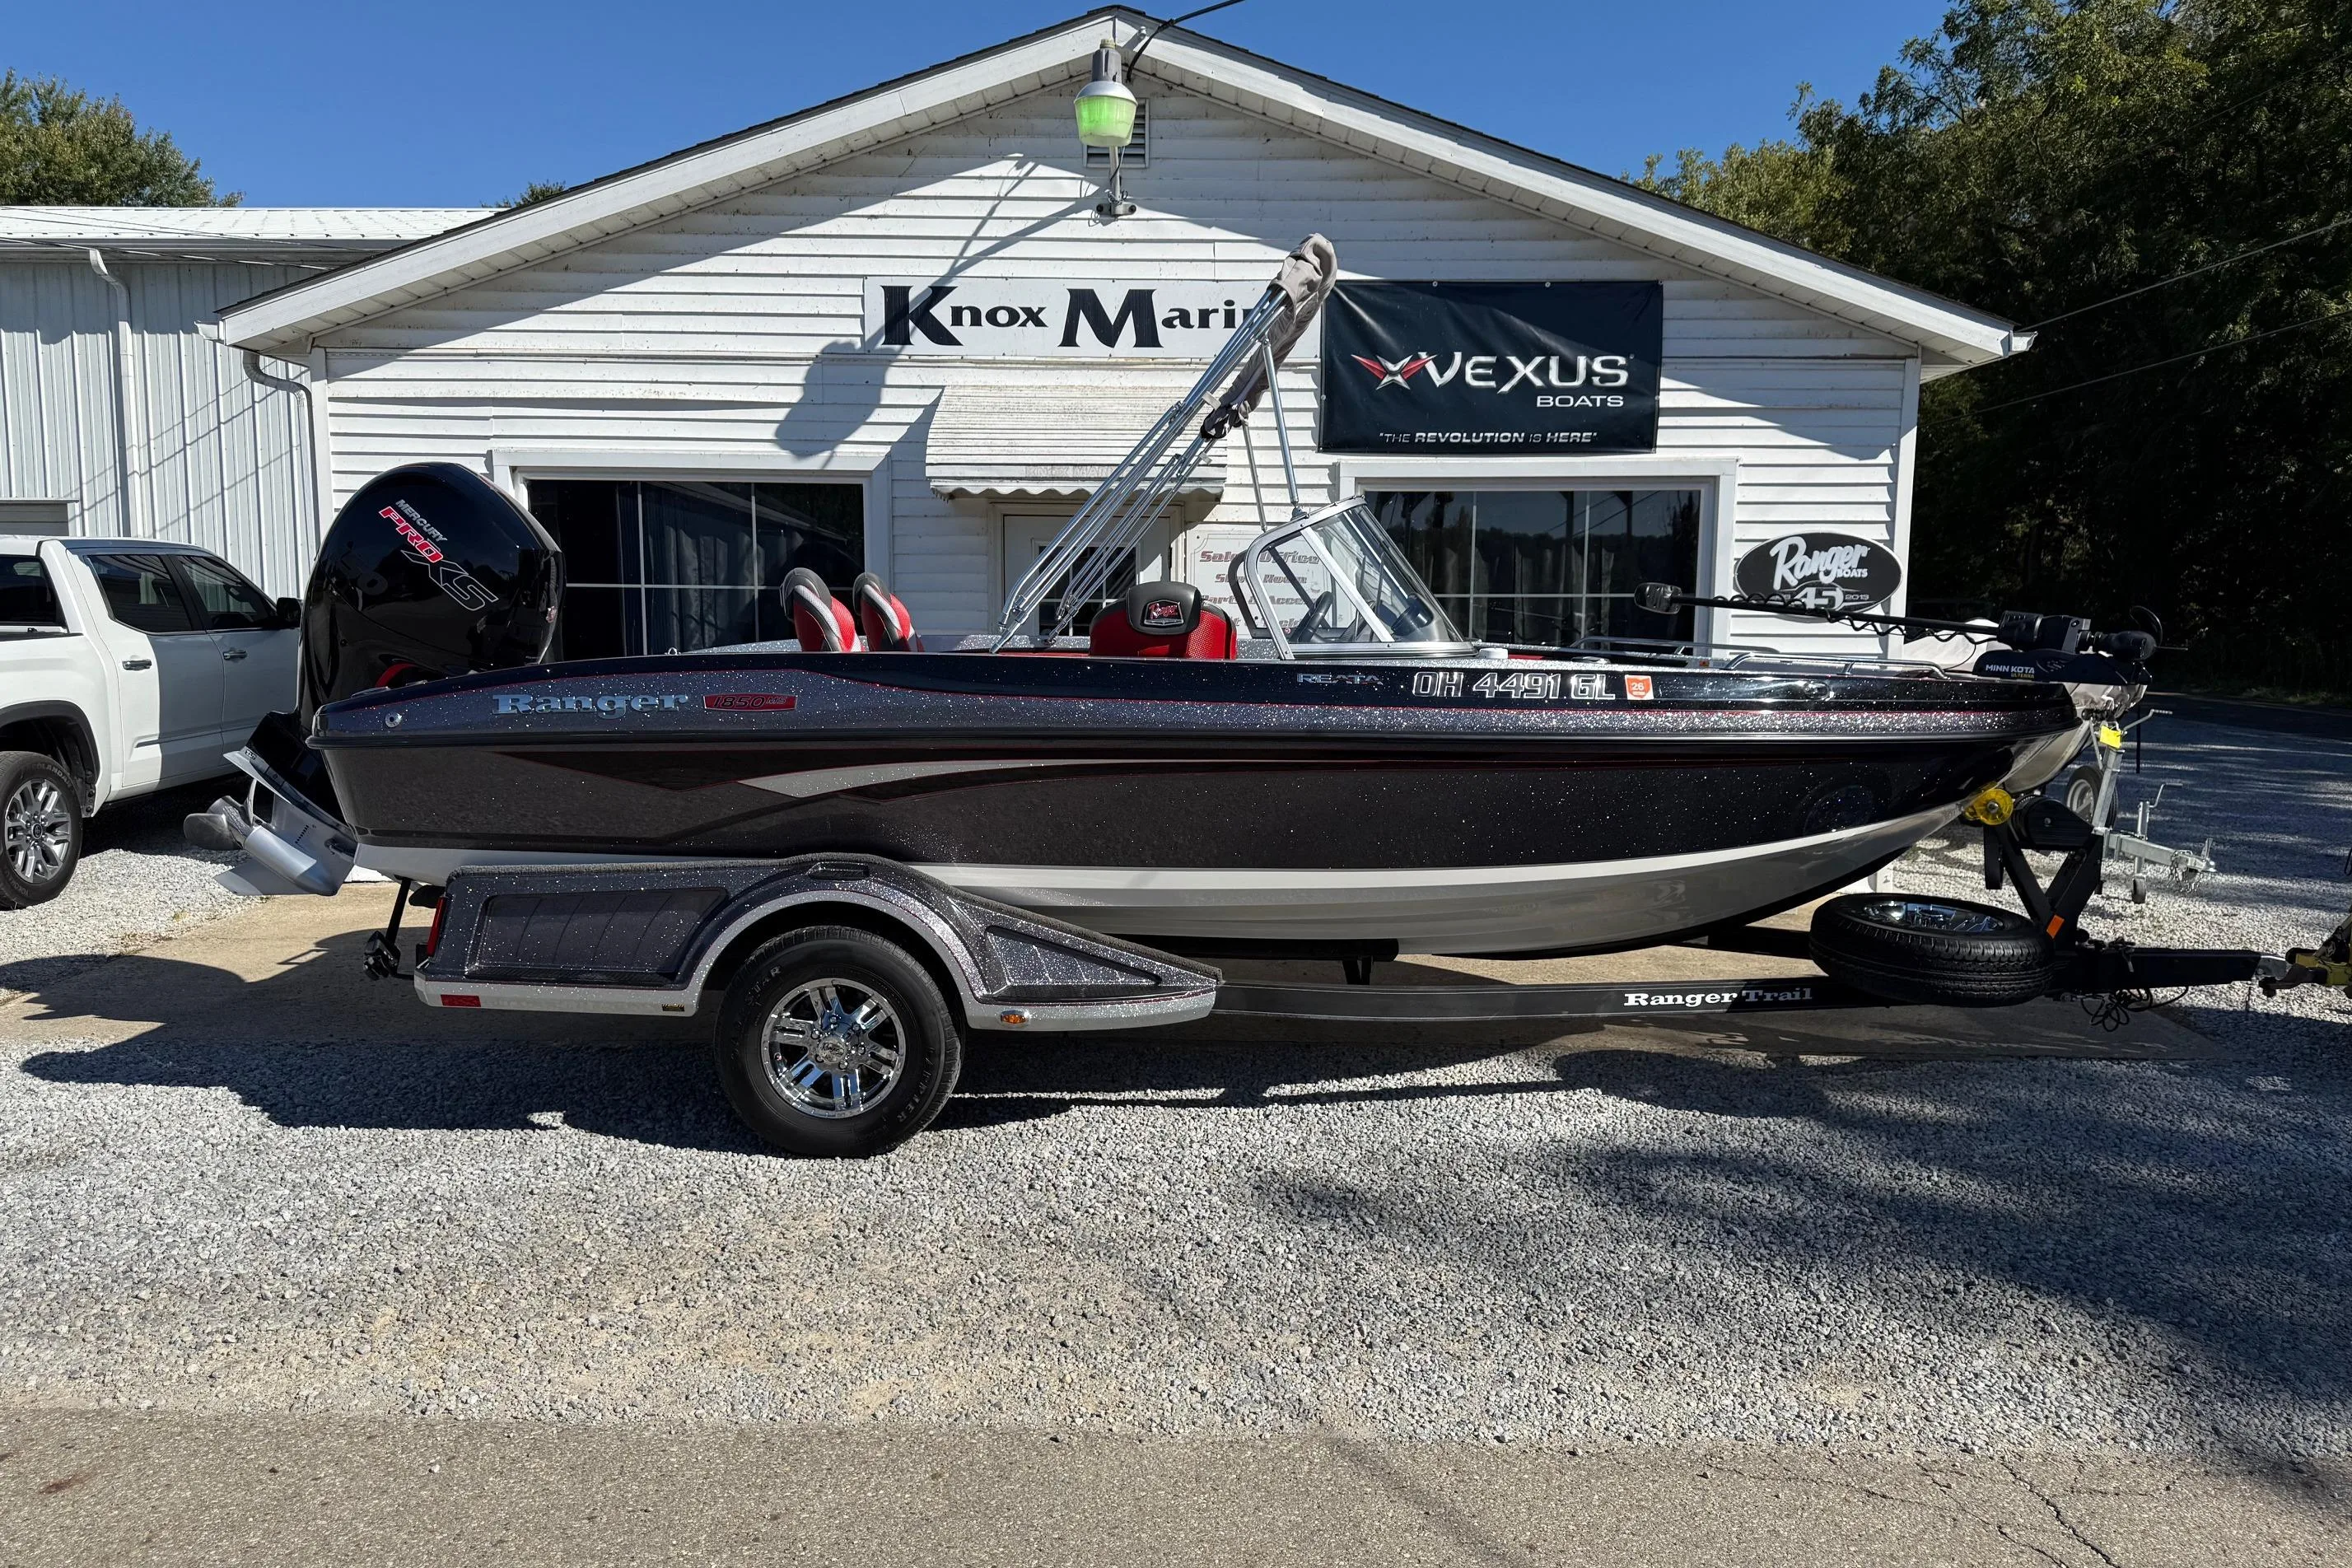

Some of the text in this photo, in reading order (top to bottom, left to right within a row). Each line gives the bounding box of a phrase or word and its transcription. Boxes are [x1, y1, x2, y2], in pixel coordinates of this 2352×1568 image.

[880, 284, 1048, 347] Knox
[1418, 352, 1630, 394] VEXUS
[1537, 394, 1624, 408] BOATS
[1414, 432, 1524, 443] REVOLUTION
[1528, 432, 1542, 443] IS
[395, 499, 448, 543] MERCURY
[379, 506, 444, 563] PRO
[1769, 535, 1869, 590] Ranger
[1836, 568, 1869, 578] BOATS
[400, 550, 500, 611] XS
[1794, 587, 1844, 610] 45
[1297, 674, 1384, 686] REATA
[1986, 664, 2035, 674] MINN KOTA
[1412, 671, 1616, 700] OH 4491 GL
[1631, 682, 1645, 691] 26
[492, 693, 688, 719] Ranger
[712, 695, 766, 707] 1850
